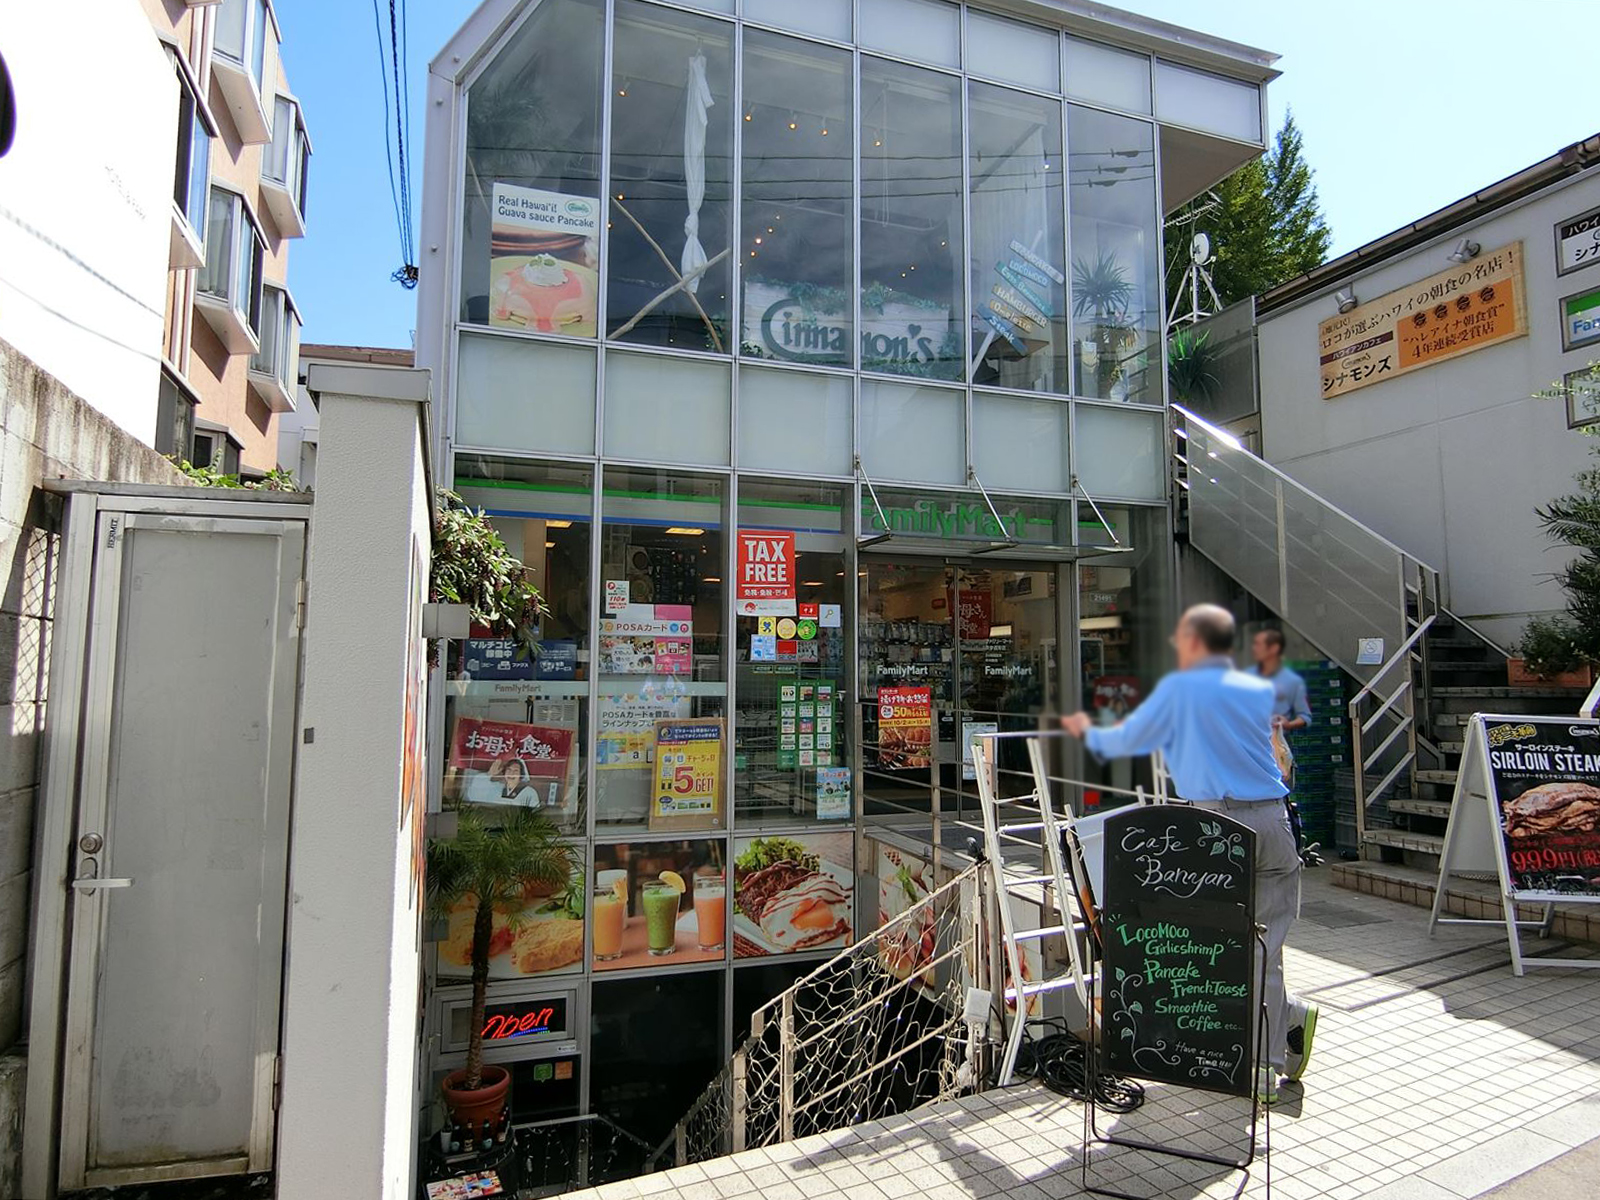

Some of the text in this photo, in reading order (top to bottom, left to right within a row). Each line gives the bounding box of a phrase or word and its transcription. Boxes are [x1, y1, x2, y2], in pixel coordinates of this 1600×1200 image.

[498, 194, 519, 207] Real
[498, 206, 594, 228] Guava sauce Pancake
[997, 287, 1048, 328] HAMBURGER
[1332, 337, 1382, 360] ハワイアンカフェ
[1323, 355, 1391, 392] シナモンズ
[744, 540, 787, 562] TAX
[744, 563, 787, 582] FREE
[616, 623, 668, 632] POSAカード
[470, 641, 518, 650] マルチコピー
[876, 665, 929, 677] FamilyMart
[984, 665, 1032, 678] FamilyMart
[495, 684, 542, 693] FamilyMart
[1514, 743, 1575, 753] サーロインステーキ
[1491, 751, 1550, 771] SIRLOIN
[674, 766, 694, 793] 5
[1121, 825, 1190, 856] Cafe
[1134, 854, 1236, 899] Banyan
[1143, 957, 1201, 985] Pancake
[1155, 997, 1219, 1014] Smoothie
[1177, 1015, 1223, 1032] Coffee
[1175, 1041, 1197, 1053] Have
